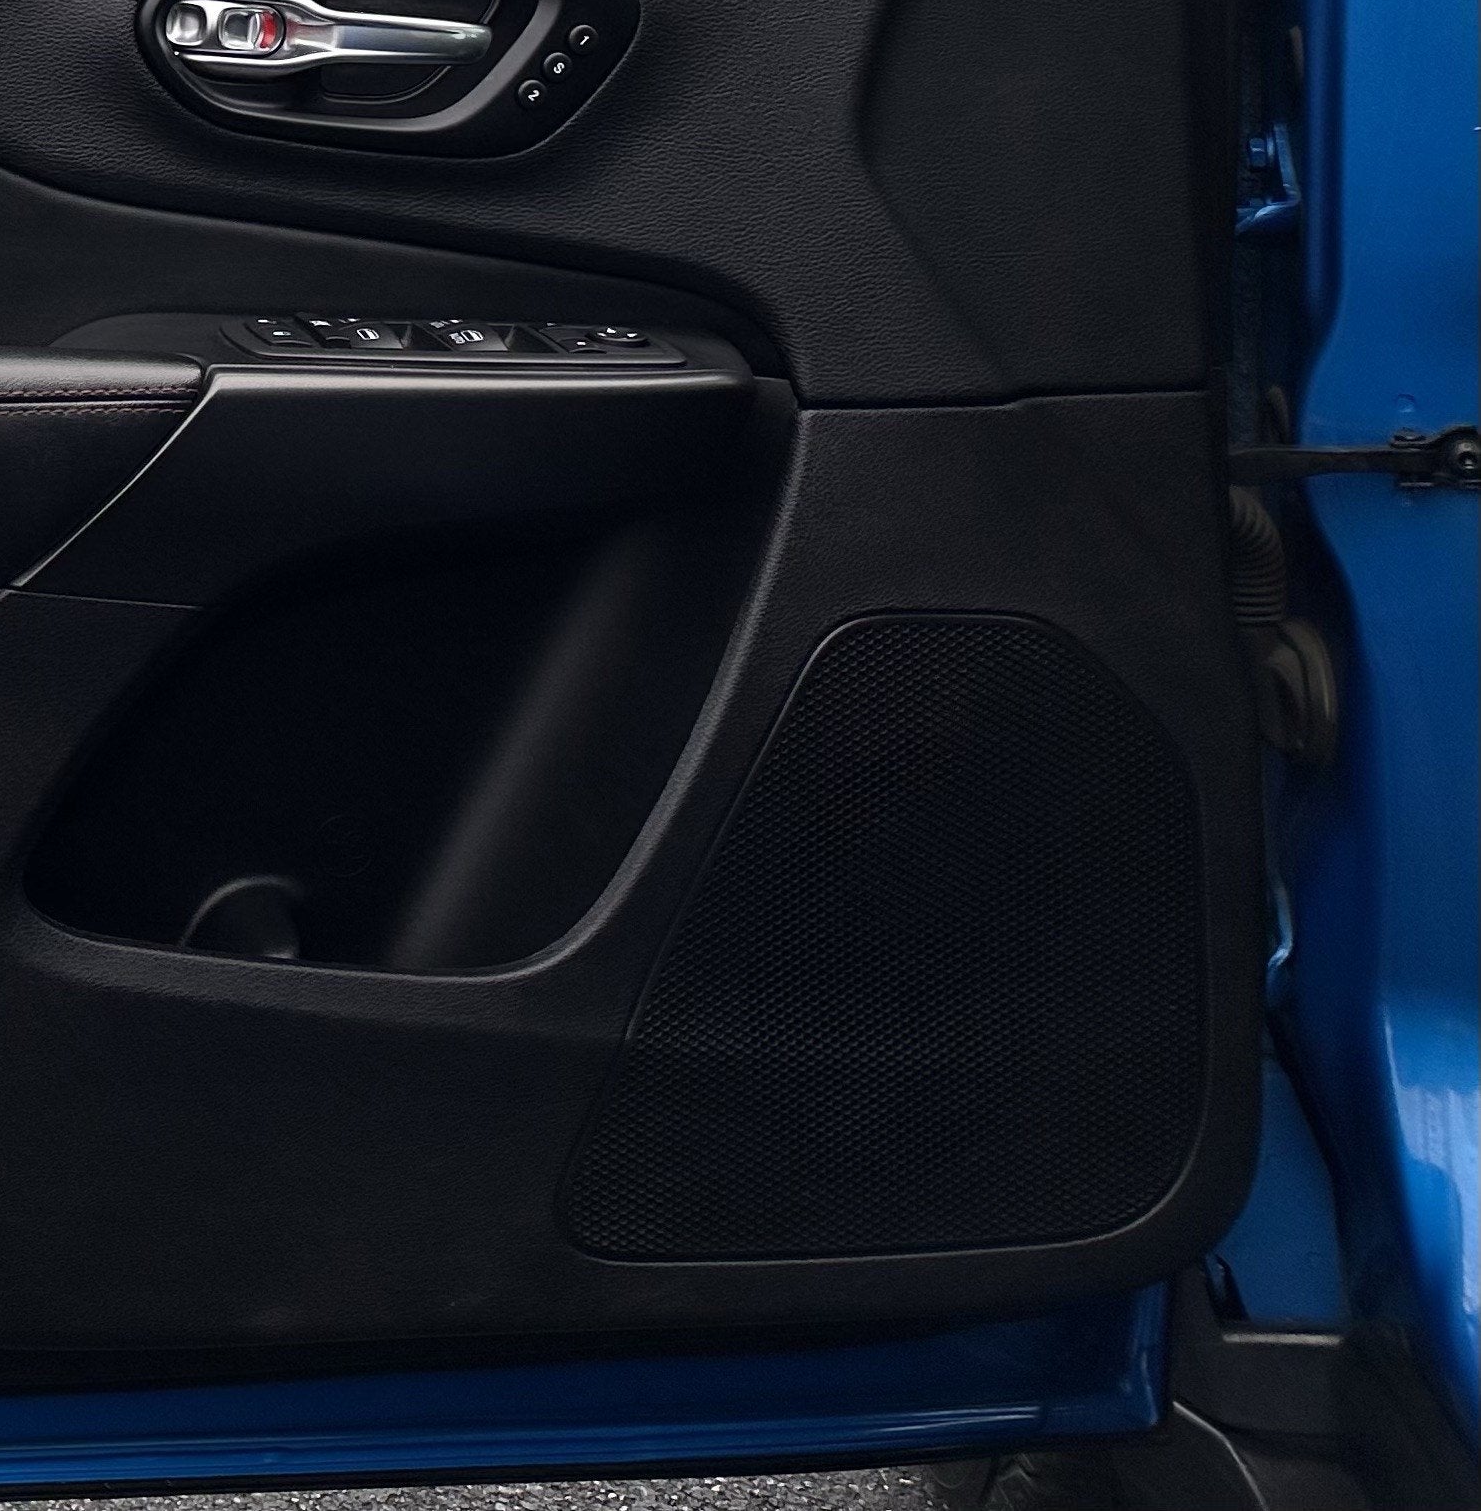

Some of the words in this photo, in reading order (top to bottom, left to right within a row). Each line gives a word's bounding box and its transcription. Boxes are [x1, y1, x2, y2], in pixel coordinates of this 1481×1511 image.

[580, 35, 590, 46] 1
[553, 62, 565, 74] S
[527, 89, 540, 102] 2
